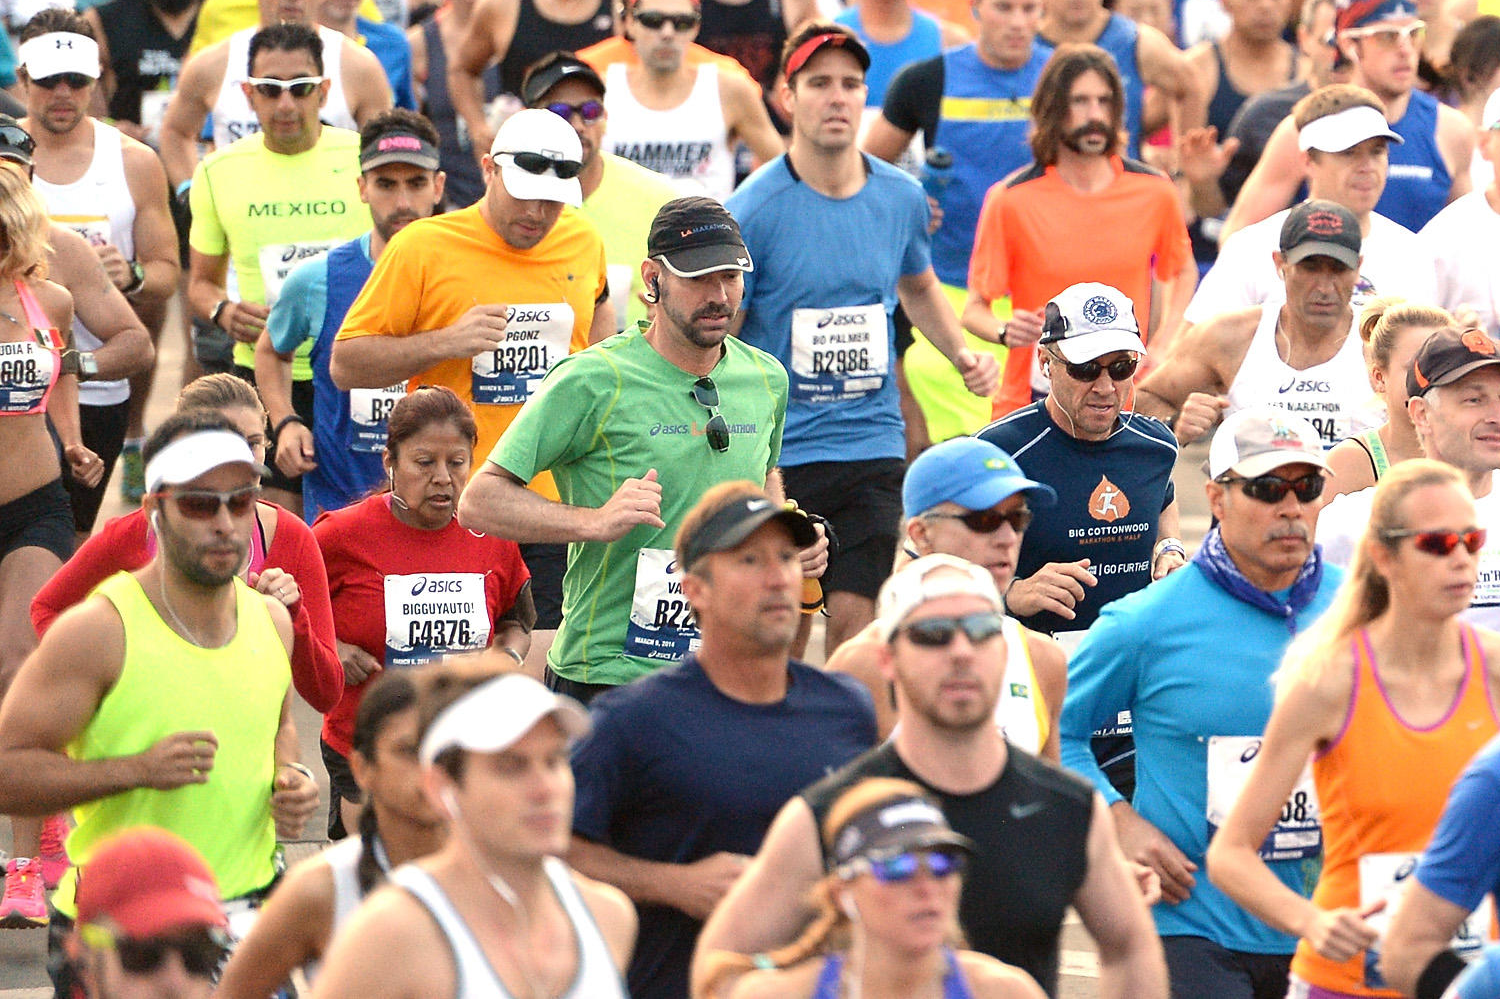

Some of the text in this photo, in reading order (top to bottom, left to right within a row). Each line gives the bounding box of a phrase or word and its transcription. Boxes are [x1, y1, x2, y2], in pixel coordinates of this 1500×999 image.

[248, 201, 346, 217] MEXICO
[516, 310, 550, 323] asics
[494, 345, 549, 374] B3201
[812, 348, 869, 374] B2986
[1296, 381, 1331, 393] asics
[1287, 402, 1340, 413] MARATHON
[662, 424, 689, 435] asics
[1068, 522, 1149, 538] BIG COTTONWOOD
[1104, 565, 1116, 575] GO
[1118, 560, 1150, 574] FURTHER
[428, 580, 462, 593] asics
[668, 582, 685, 594] VA
[402, 602, 475, 615] BIGGUYAUTO!
[408, 618, 470, 647] C4376
